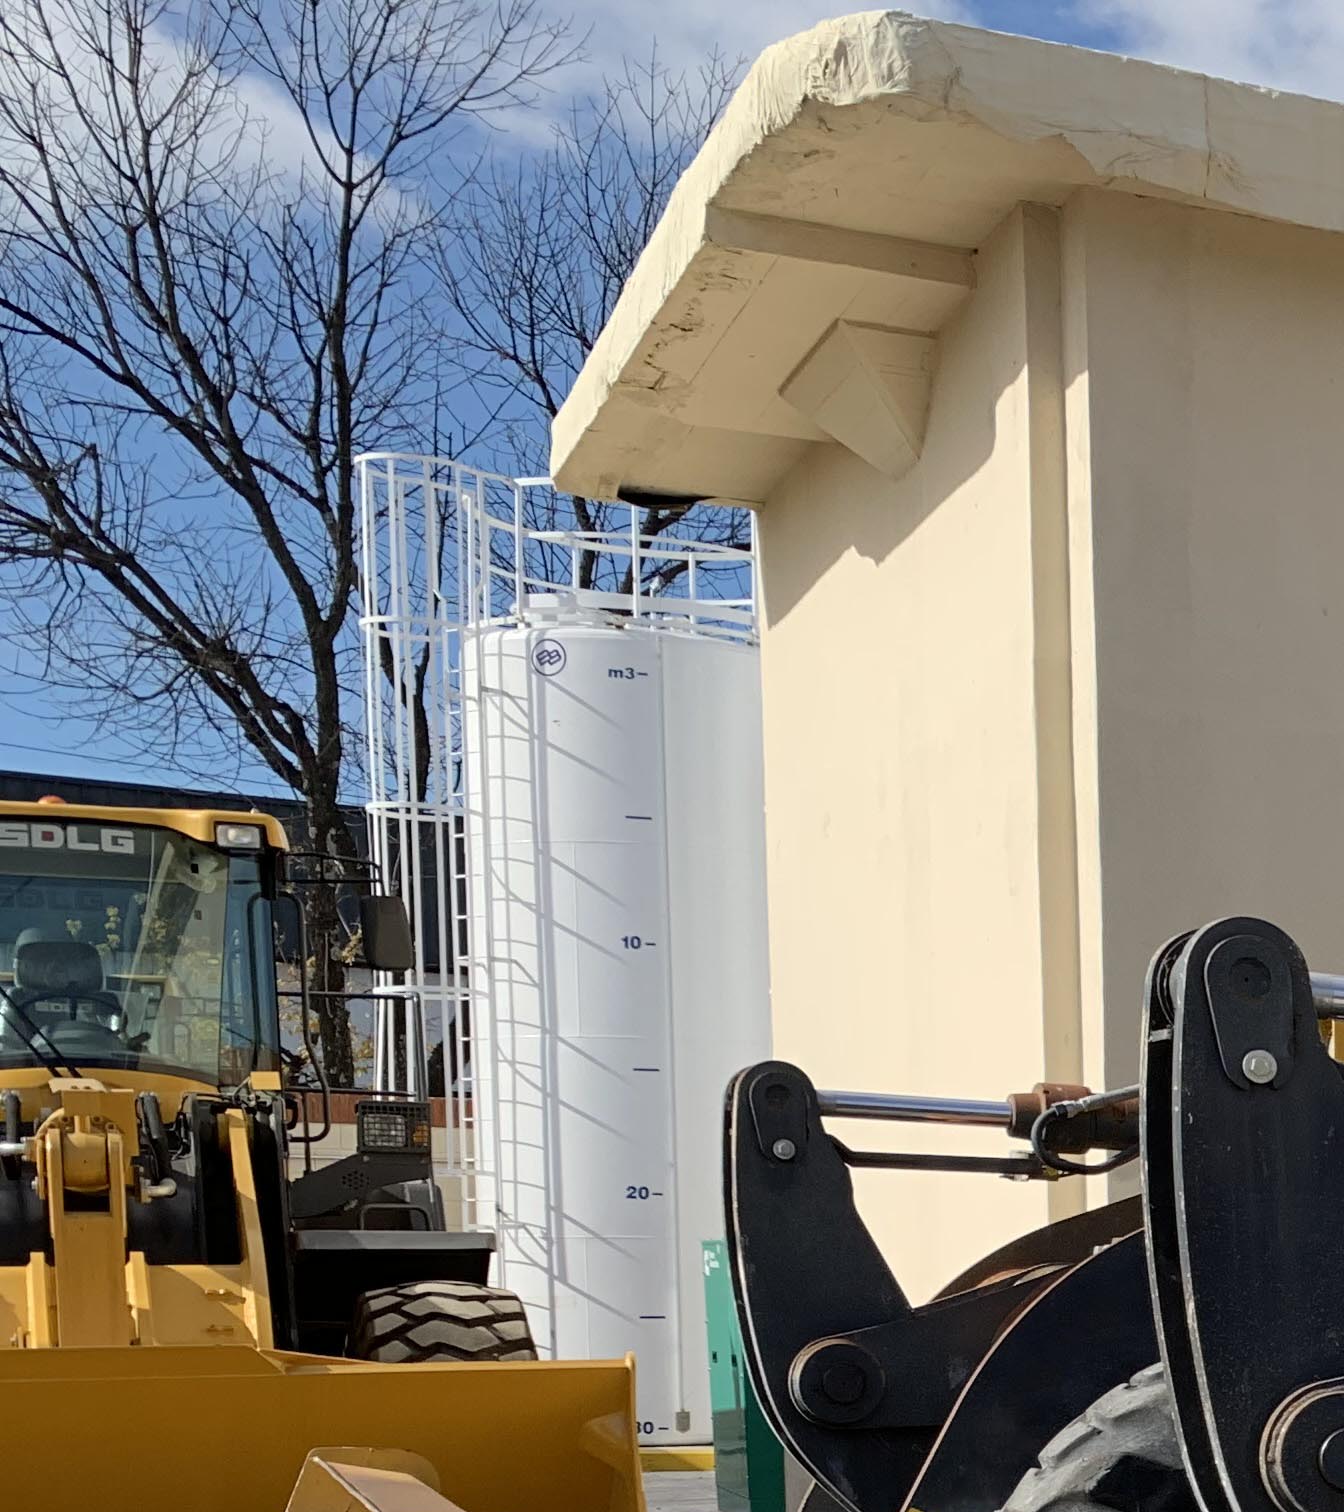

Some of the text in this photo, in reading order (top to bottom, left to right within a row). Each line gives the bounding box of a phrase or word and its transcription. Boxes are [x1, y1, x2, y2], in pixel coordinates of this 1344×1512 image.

[0, 823, 135, 854] SDLG
[622, 935, 641, 949] 10
[627, 1185, 649, 1200] 20
